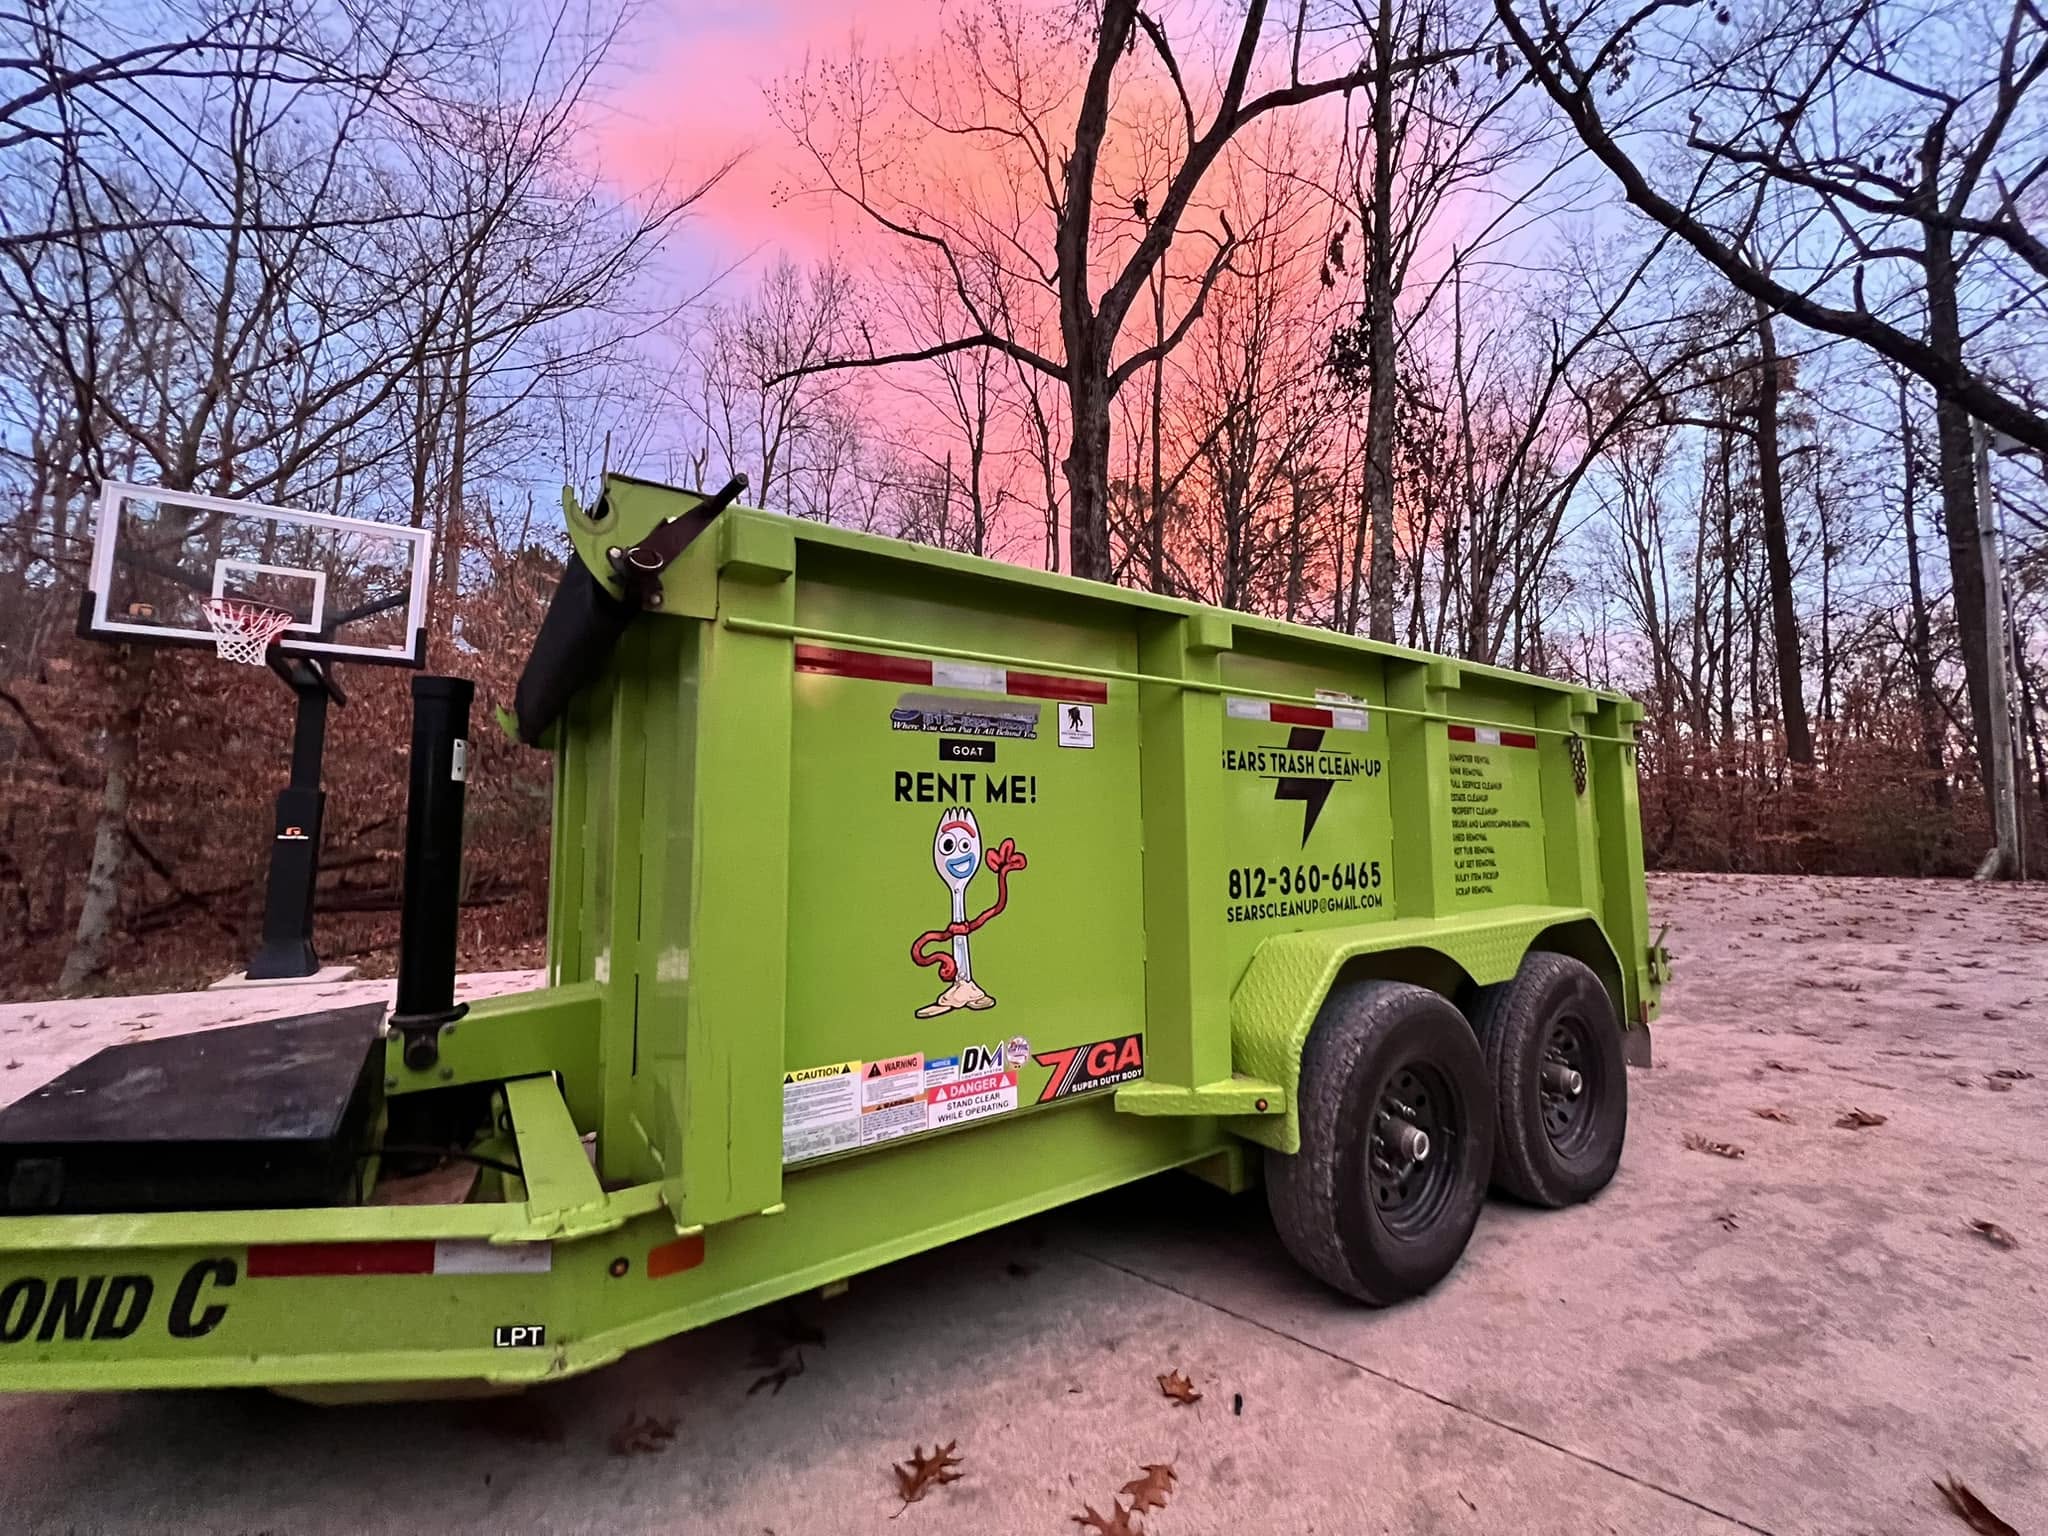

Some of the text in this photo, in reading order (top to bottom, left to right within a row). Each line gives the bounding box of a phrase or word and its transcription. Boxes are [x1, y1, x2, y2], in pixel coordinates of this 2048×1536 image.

[893, 721, 919, 731] Where
[922, 724, 937, 732] You
[940, 725, 957, 733] Can
[982, 728, 994, 736] All
[996, 728, 1021, 737] Behind
[952, 746, 984, 757] GOAT
[1271, 753, 1315, 775] TRASH
[1318, 756, 1382, 777] CLEAN-UP
[894, 771, 1037, 804] RENT ME!
[1228, 861, 1382, 900] 812-360-6465
[1227, 895, 1382, 923] SEARSCLEANUP@GMAIL.COM
[884, 1057, 918, 1073] WARNING
[962, 1043, 1004, 1075] DM
[796, 1066, 840, 1082] CAUTION
[1071, 1069, 1143, 1093] SUPER DUTY BODY
[950, 1077, 998, 1098] DANGER
[937, 1100, 1009, 1123] WHILE OPERATING
[946, 1092, 1001, 1111] STAND CLEAR
[167, 1257, 239, 1338] C
[495, 1326, 543, 1347] LPT
